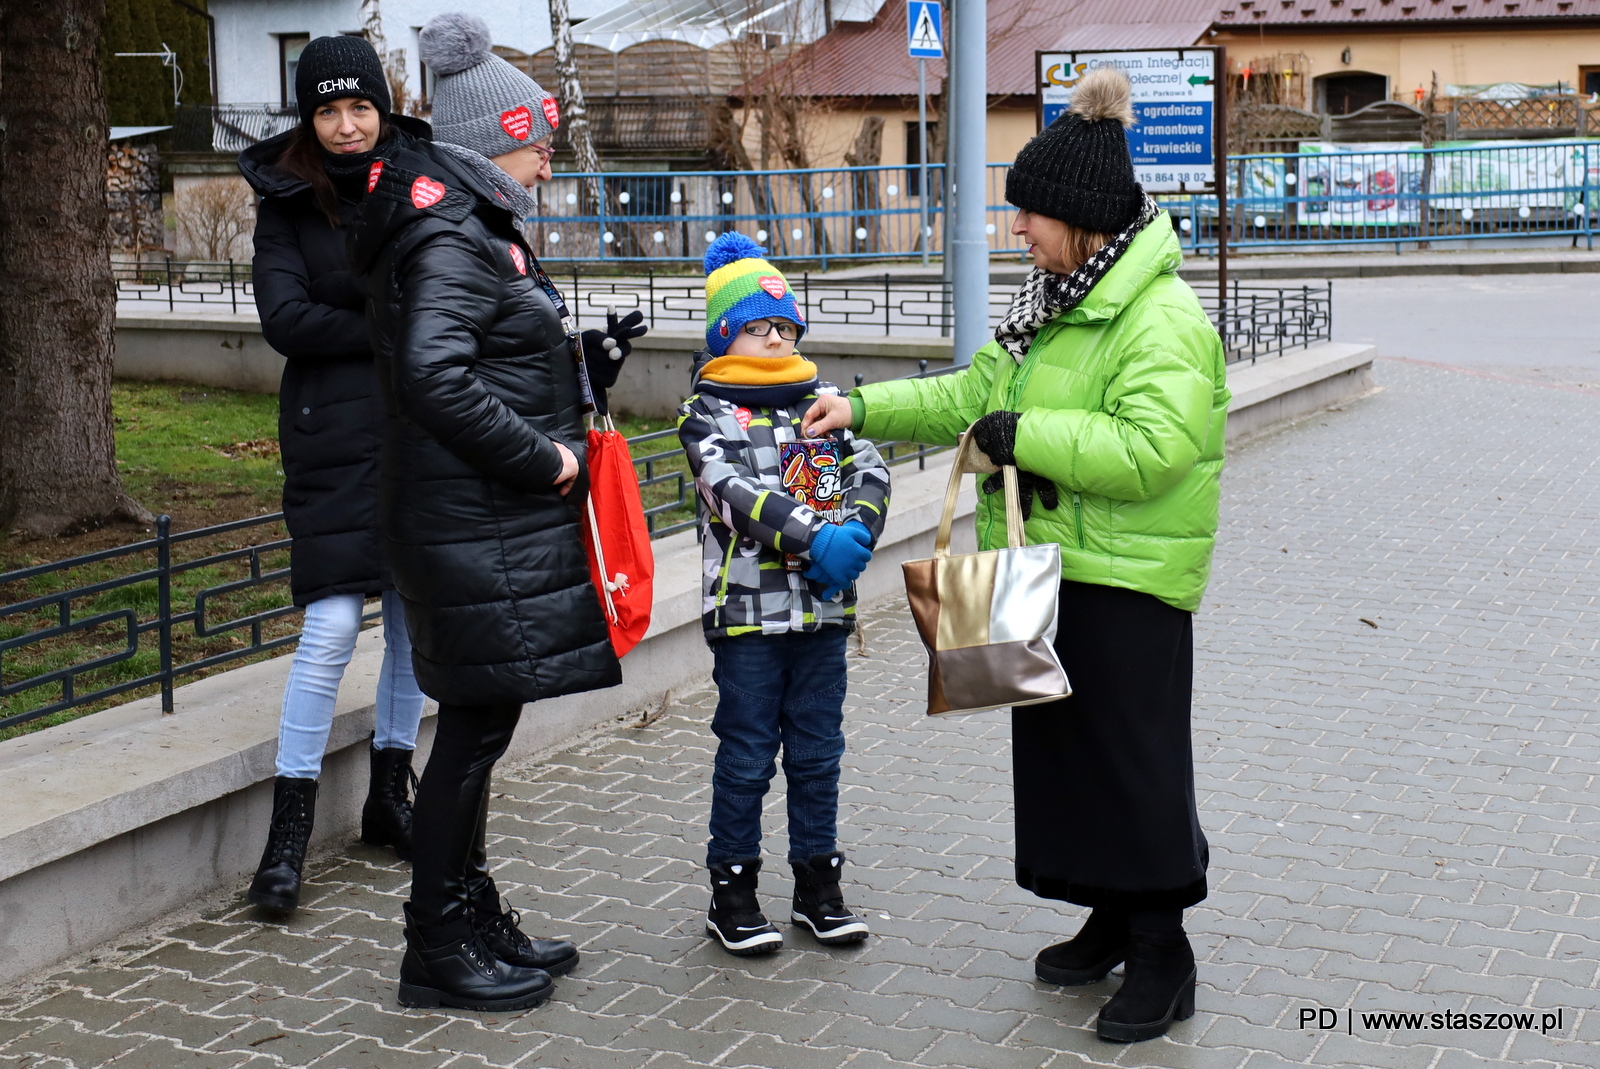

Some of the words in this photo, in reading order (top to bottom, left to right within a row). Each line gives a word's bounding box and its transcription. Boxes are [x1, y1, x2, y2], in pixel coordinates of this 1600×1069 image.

[1089, 57, 1143, 70] Centrum
[1147, 55, 1210, 70] Integracji
[317, 77, 360, 94] OCHNIK
[1129, 72, 1182, 86] ołecznej
[1143, 104, 1203, 119] ogrodnicze
[1143, 123, 1204, 135] remontowe
[1143, 142, 1202, 154] krawieckie
[1139, 173, 1152, 182] 15
[1155, 173, 1174, 182] 864
[1177, 172, 1190, 182] 38
[1193, 172, 1207, 182] 02
